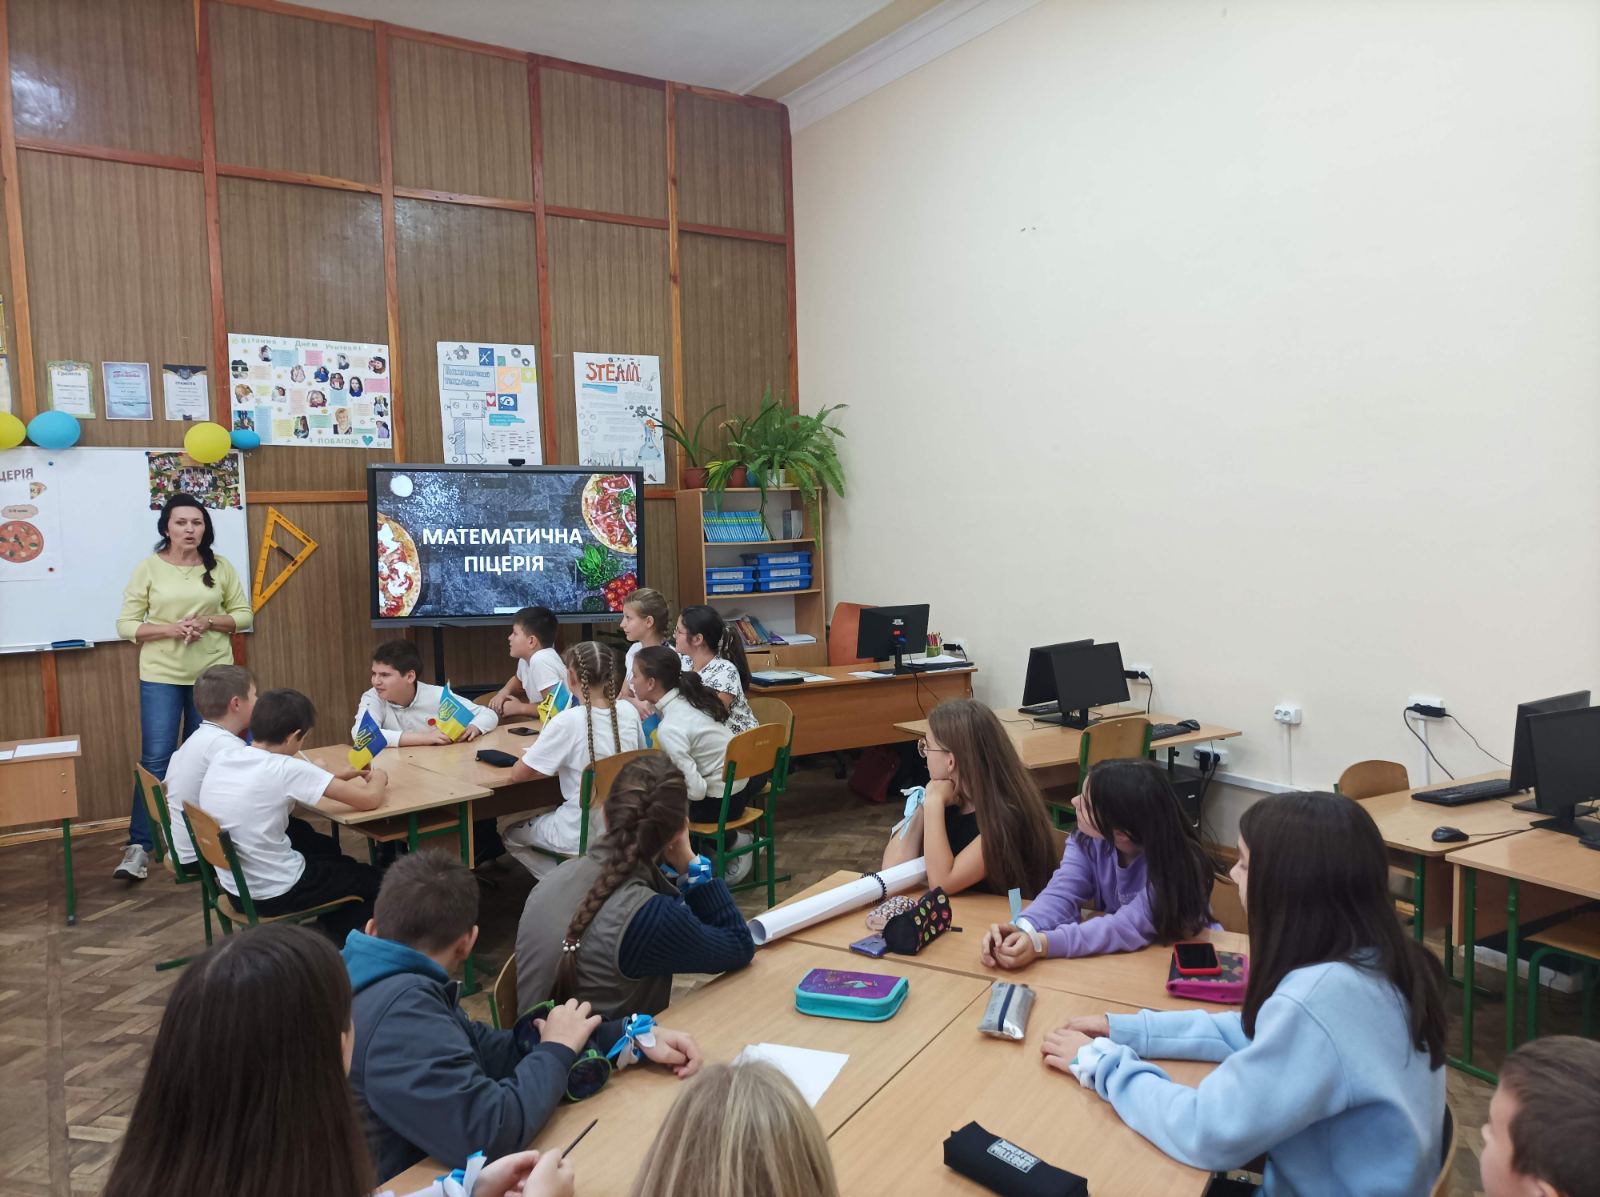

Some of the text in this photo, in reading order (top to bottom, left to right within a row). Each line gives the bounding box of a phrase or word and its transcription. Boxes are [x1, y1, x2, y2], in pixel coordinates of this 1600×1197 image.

[586, 361, 641, 382] STEAM
[422, 528, 583, 545] МАТЕМАТИЧНА
[464, 555, 544, 576] ПІЦЕРІЯ
